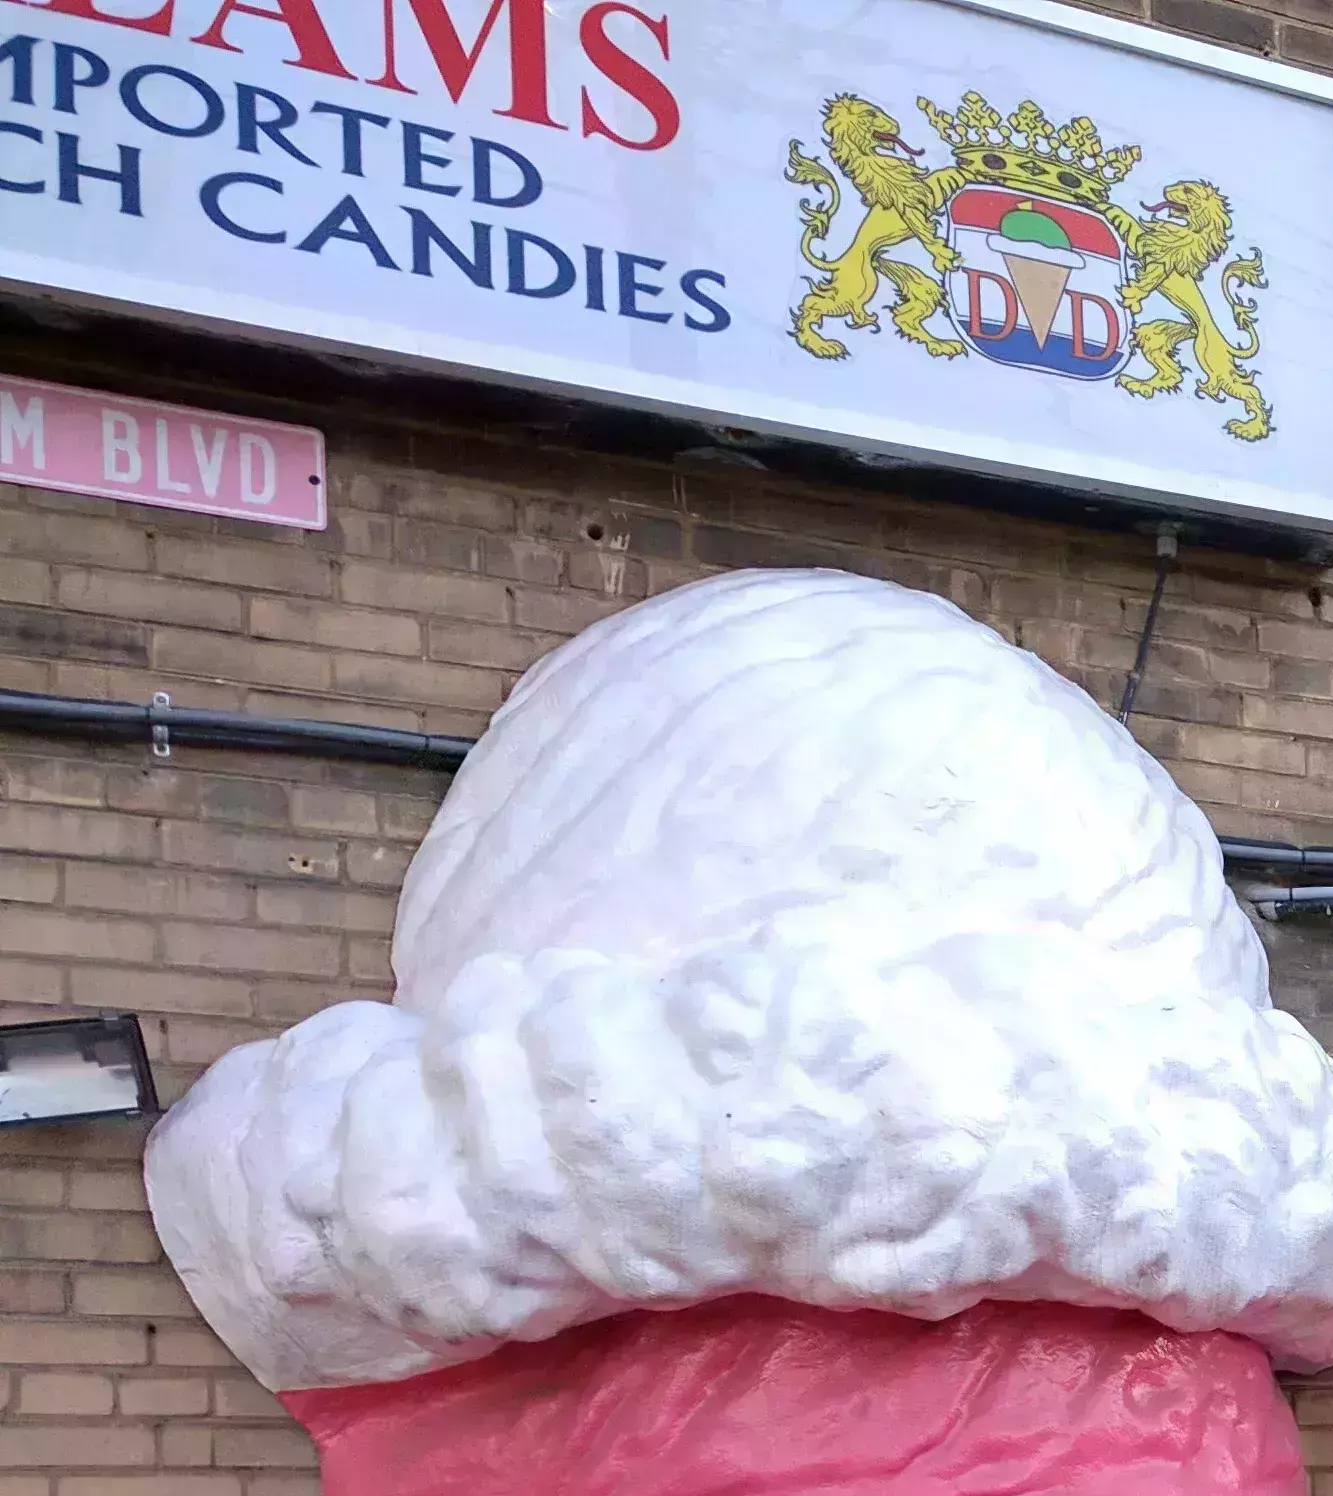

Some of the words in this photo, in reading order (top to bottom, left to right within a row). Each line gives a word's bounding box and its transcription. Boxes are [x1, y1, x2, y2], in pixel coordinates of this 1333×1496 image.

[0, 0, 682, 151] AMS
[198, 171, 732, 333] CANDIES
[101, 407, 276, 505] BLVD
